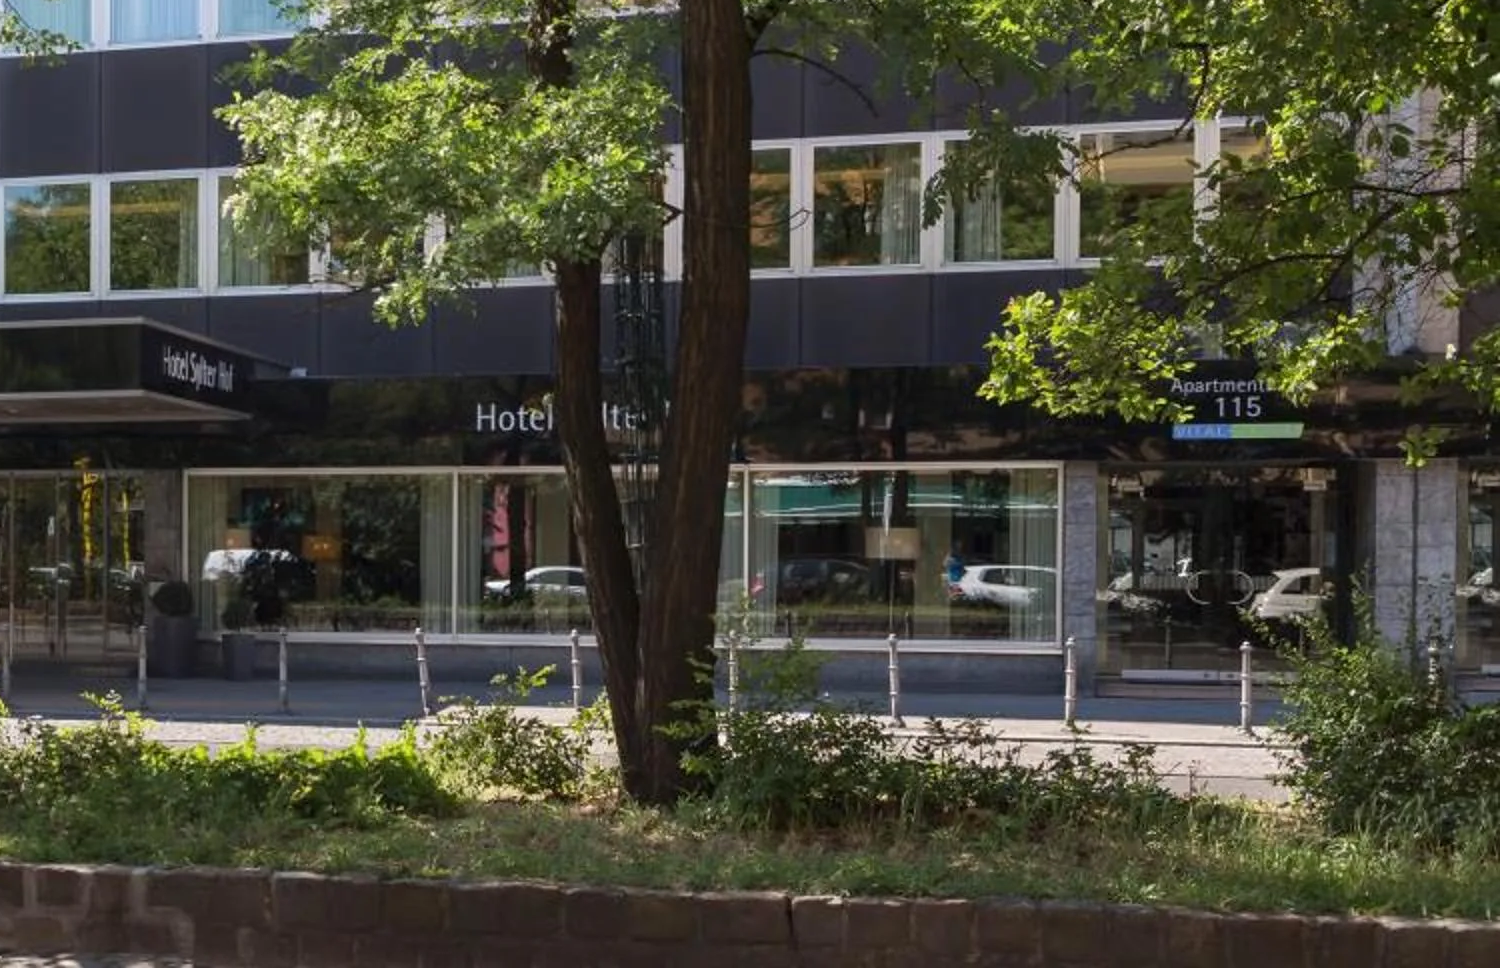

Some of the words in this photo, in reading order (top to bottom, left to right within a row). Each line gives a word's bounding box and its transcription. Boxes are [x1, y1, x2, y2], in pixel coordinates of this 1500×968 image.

[1171, 378, 1277, 396] Apartment
[476, 401, 553, 431] Hotel
[1215, 396, 1262, 417] 115
